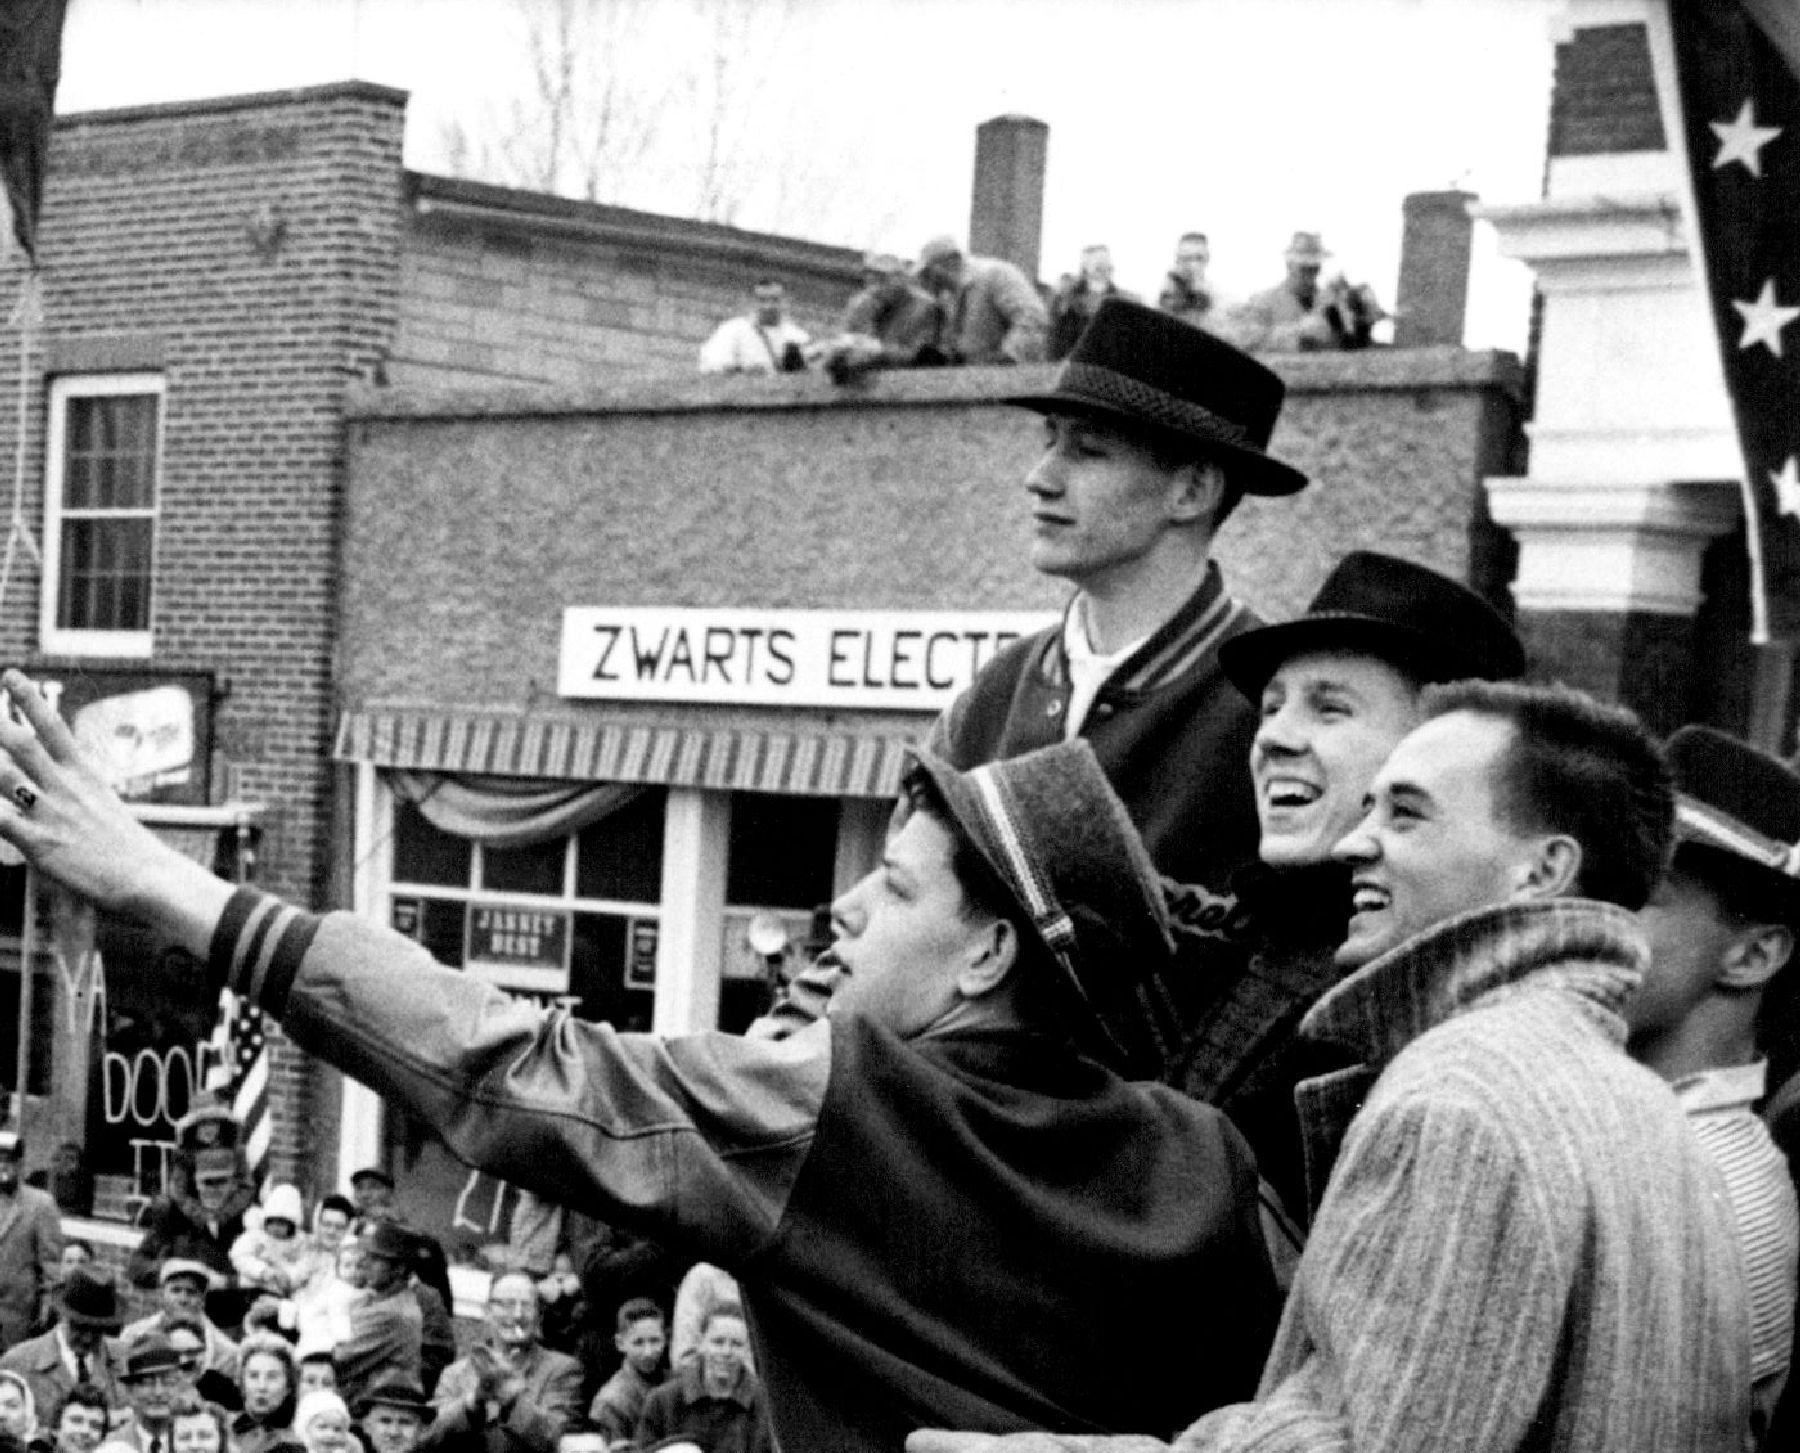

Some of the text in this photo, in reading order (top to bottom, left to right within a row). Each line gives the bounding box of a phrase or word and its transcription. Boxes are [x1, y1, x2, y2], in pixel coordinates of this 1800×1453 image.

[591, 624, 1022, 690] ZWARTS ELECT
[48, 945, 107, 1038] YA
